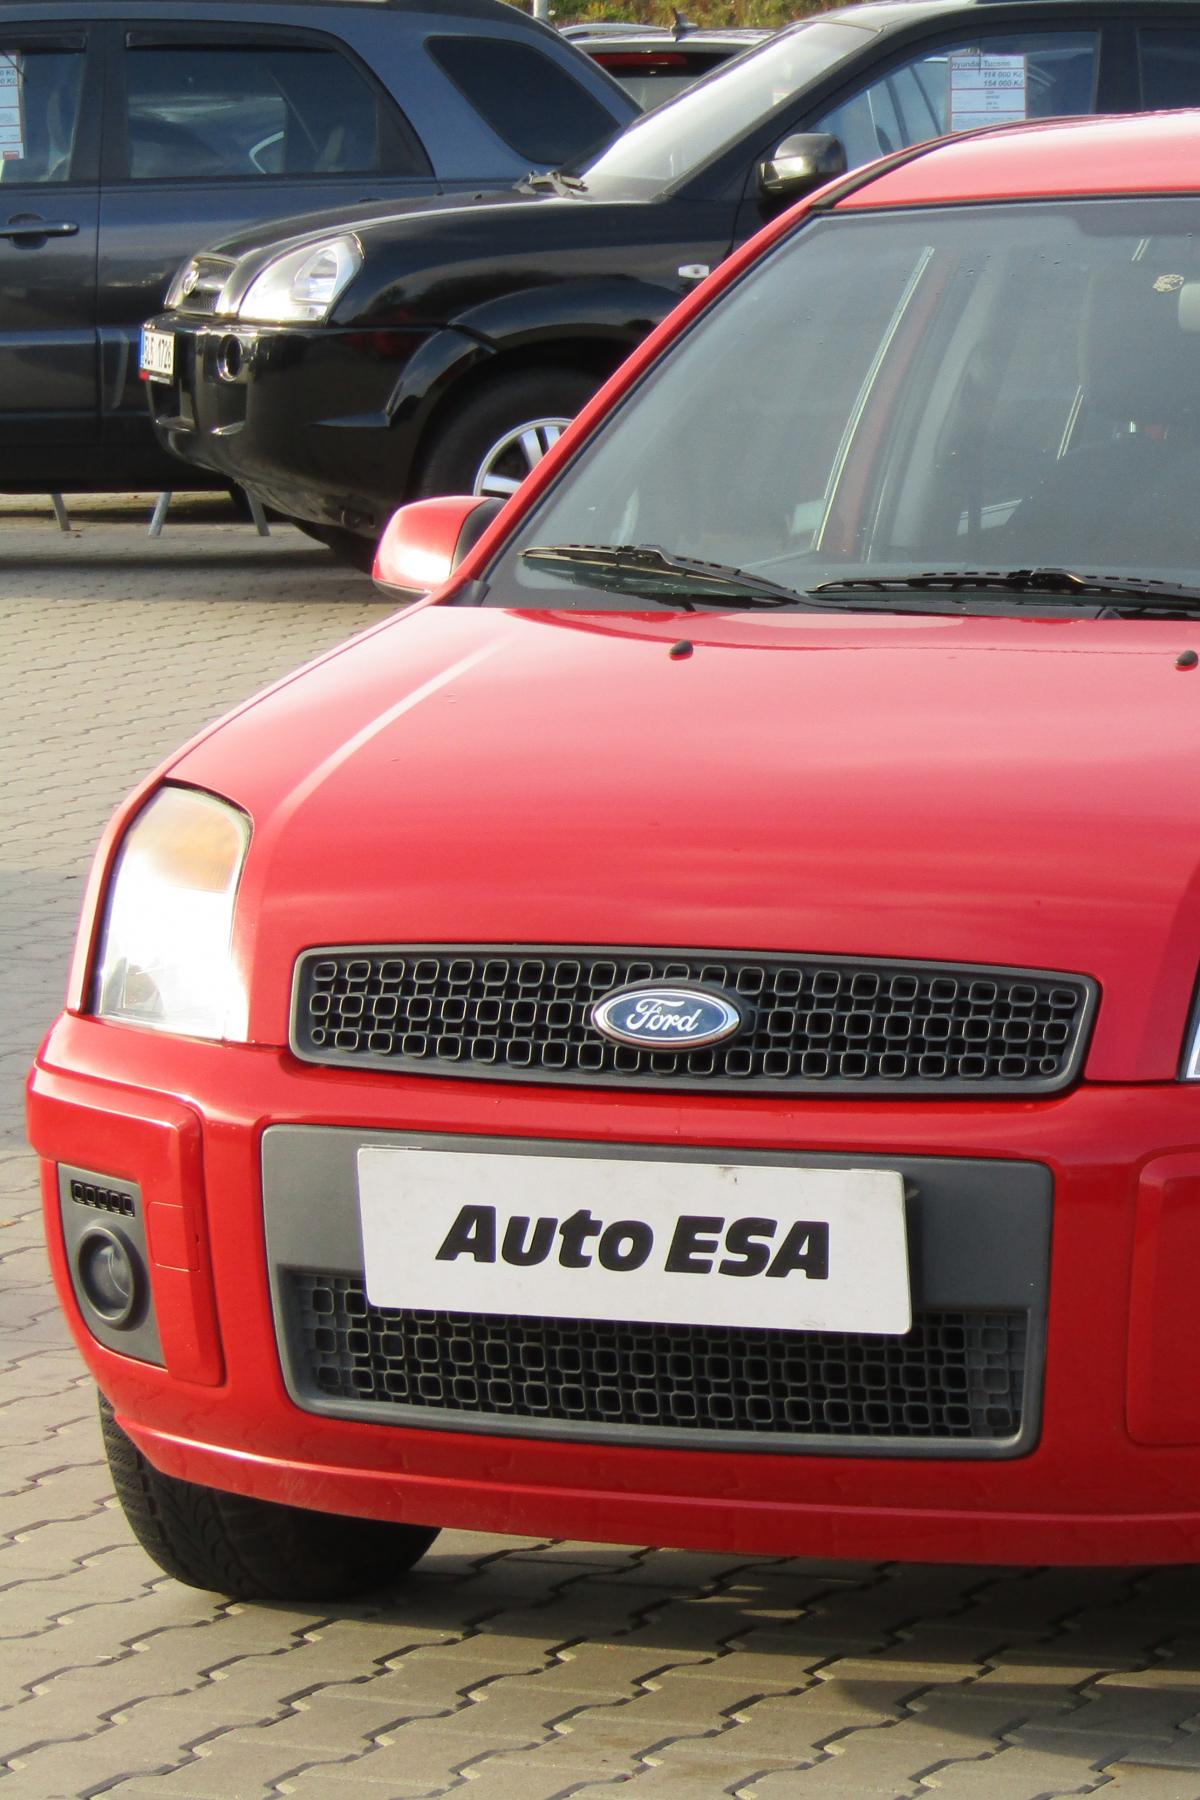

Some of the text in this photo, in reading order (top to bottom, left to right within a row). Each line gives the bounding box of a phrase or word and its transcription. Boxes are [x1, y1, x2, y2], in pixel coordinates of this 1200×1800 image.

[626, 998, 702, 1032] Ford
[435, 1204, 829, 1280] Auto ESA
